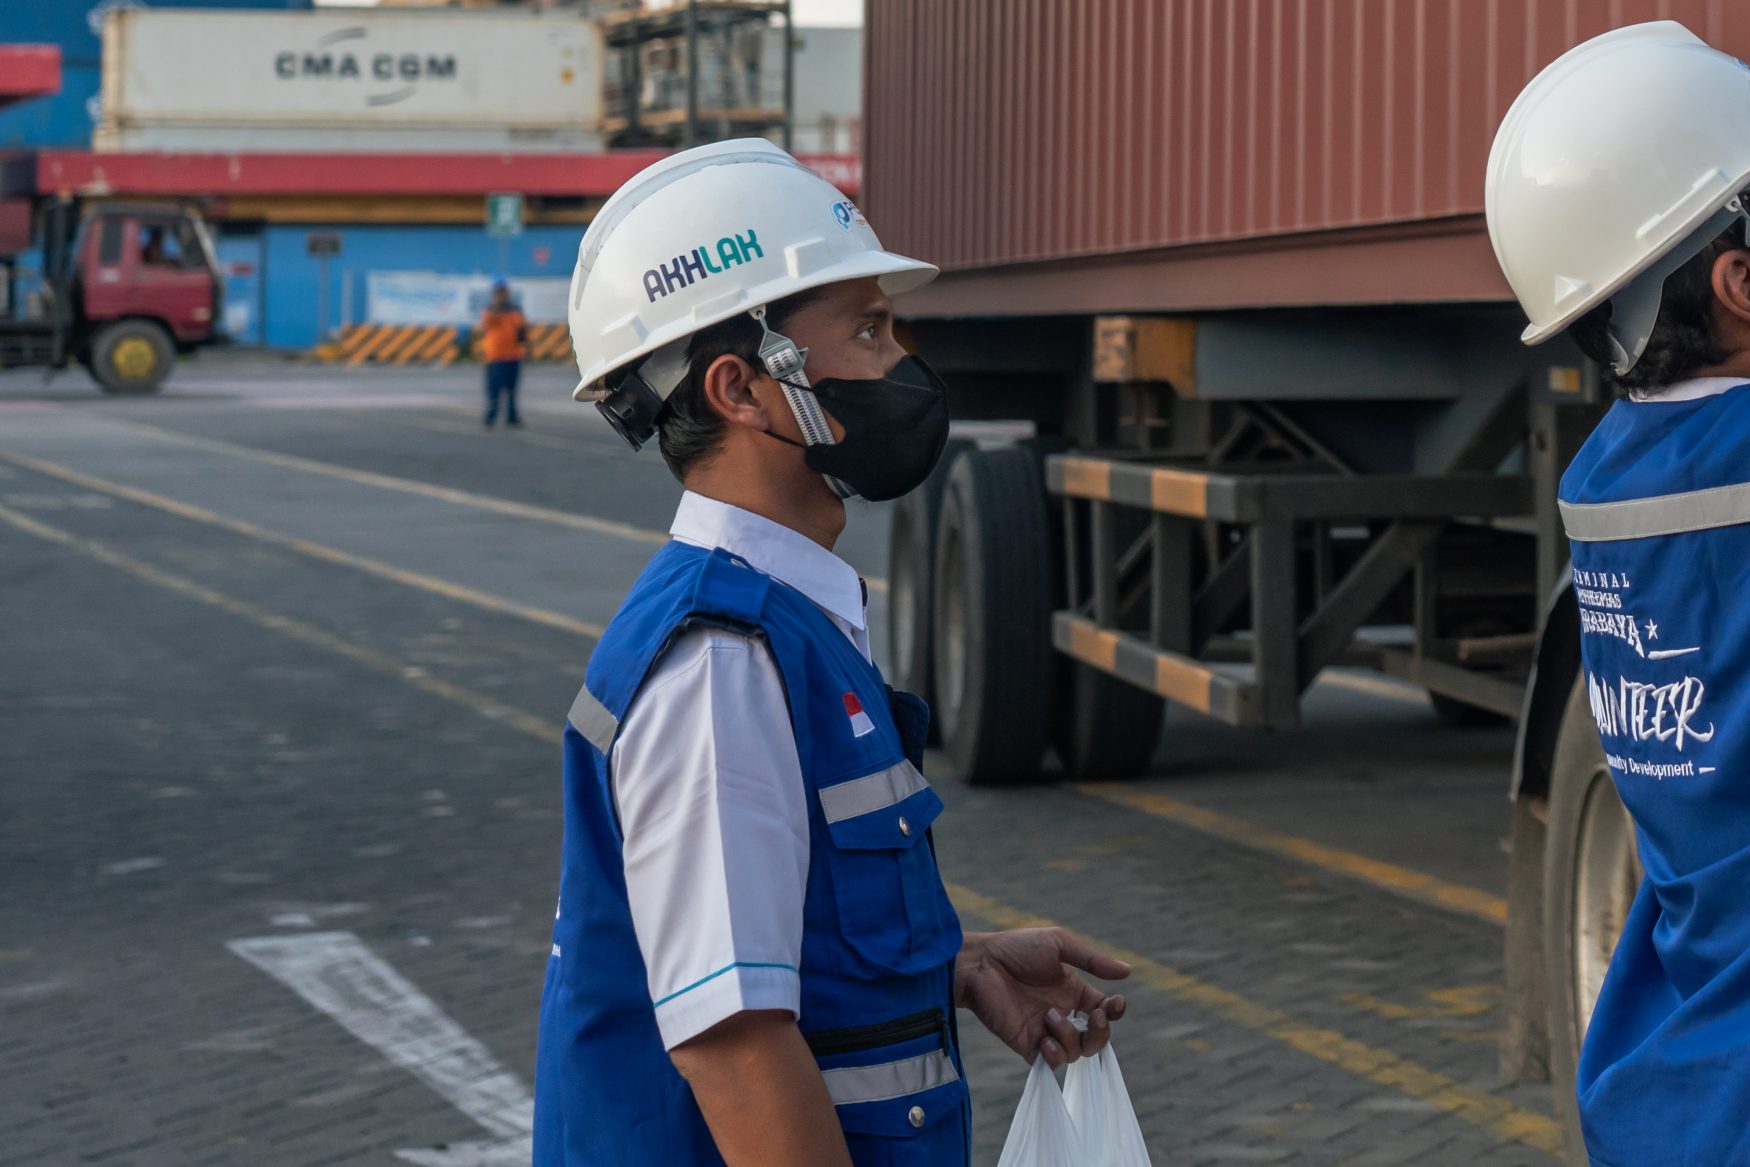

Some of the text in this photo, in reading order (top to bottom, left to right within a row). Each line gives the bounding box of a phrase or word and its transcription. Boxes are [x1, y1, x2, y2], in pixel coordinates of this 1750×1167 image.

[275, 52, 457, 81] CMA CGM
[642, 229, 764, 303] AKHLAK
[1629, 758, 1695, 781] Development
